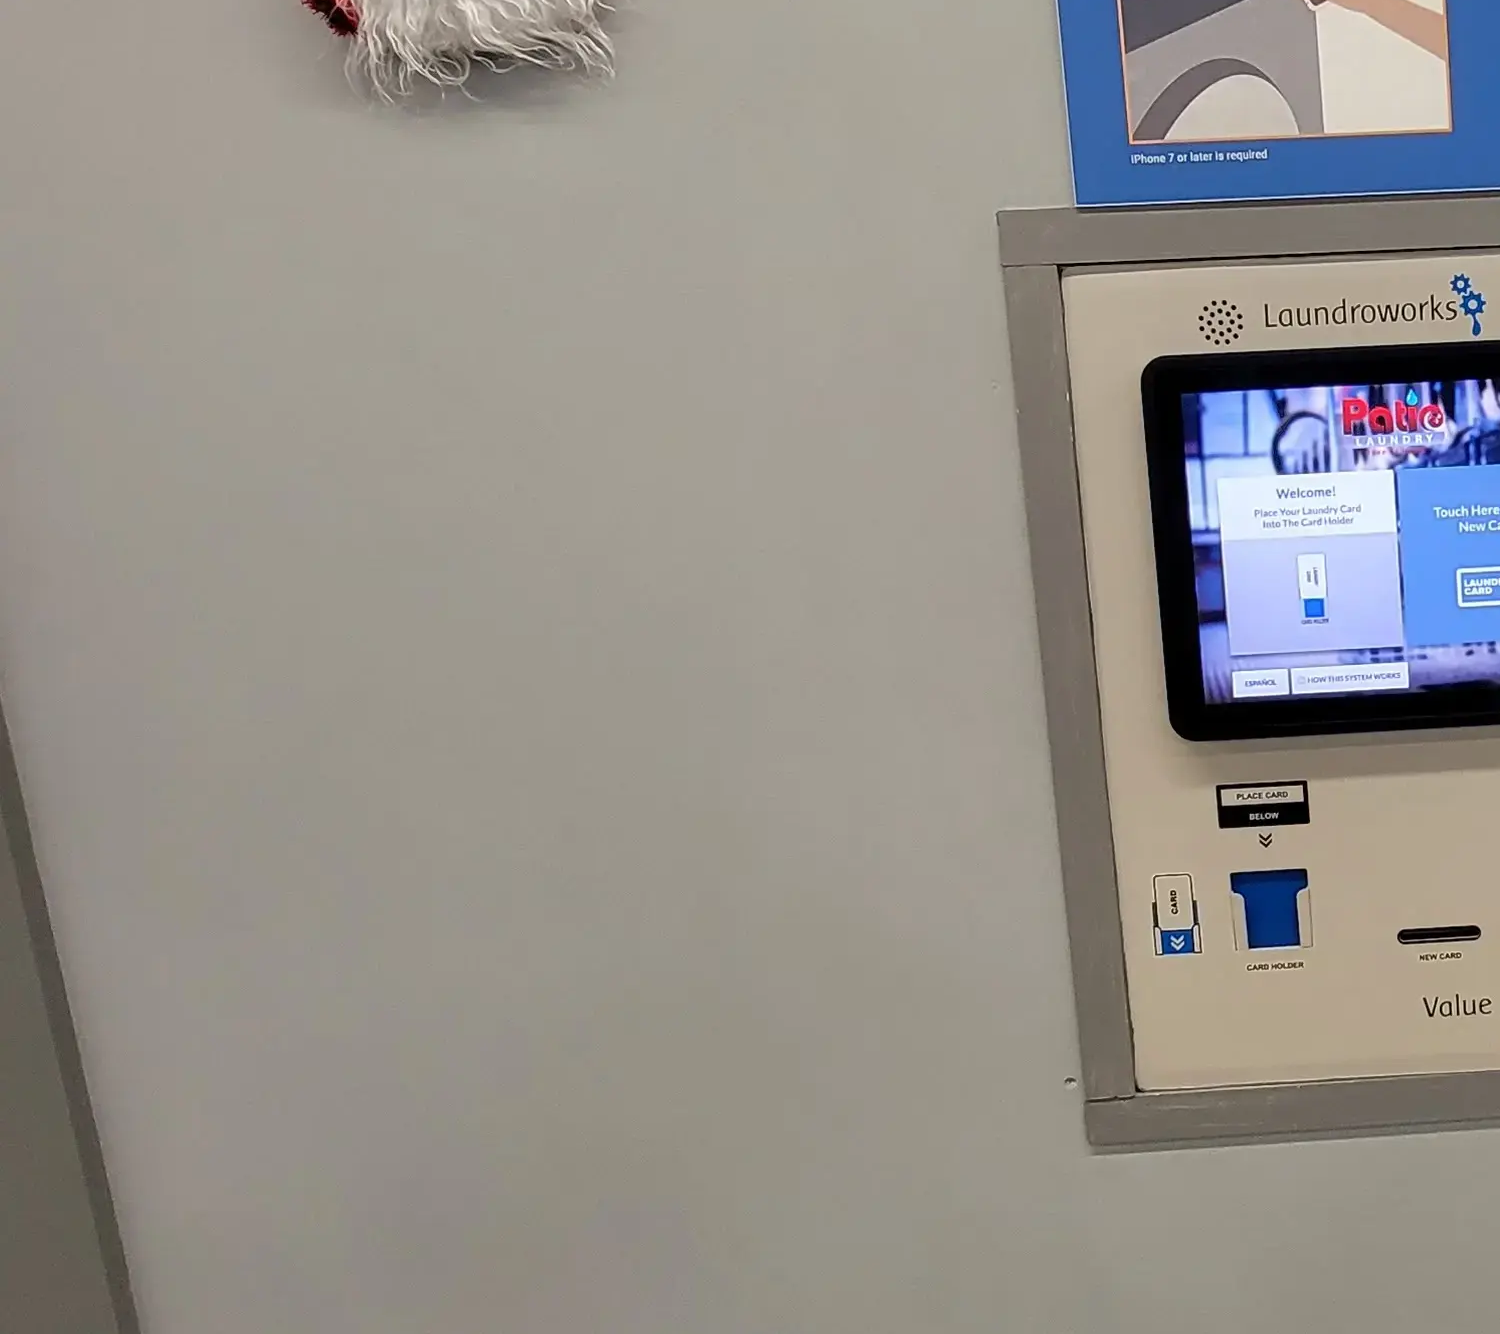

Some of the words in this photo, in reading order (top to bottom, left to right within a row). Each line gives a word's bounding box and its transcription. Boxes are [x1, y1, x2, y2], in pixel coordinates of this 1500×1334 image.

[1168, 152, 1175, 163] 7
[1177, 153, 1188, 163] or
[1190, 151, 1213, 163] later
[1226, 148, 1268, 163] required
[1263, 294, 1459, 330] Laundroworks
[1342, 389, 1445, 436] Patio
[1355, 433, 1435, 447] LAUNDRY
[1275, 486, 1337, 500] Welcome!
[1253, 508, 1278, 519] Place
[1280, 507, 1300, 516] Your
[1302, 505, 1338, 516] Laundry
[1340, 503, 1362, 514] Card
[1432, 504, 1469, 519] Touch
[1471, 504, 1500, 517] Here
[1262, 519, 1281, 529] Into
[1282, 518, 1299, 528] The
[1300, 517, 1322, 528] Card
[1324, 516, 1355, 526] Holder
[1458, 520, 1486, 533] New
[1463, 586, 1494, 597] CARD
[1235, 791, 1264, 802] PLACE
[1265, 789, 1289, 800] CARD
[1248, 810, 1280, 822] BELOW
[1169, 888, 1179, 916] CARD
[1418, 953, 1438, 962] NEW
[1439, 951, 1463, 962] CARD
[1246, 962, 1269, 972] CARD
[1270, 960, 1305, 971] HOLDER
[1422, 993, 1493, 1018] Value
